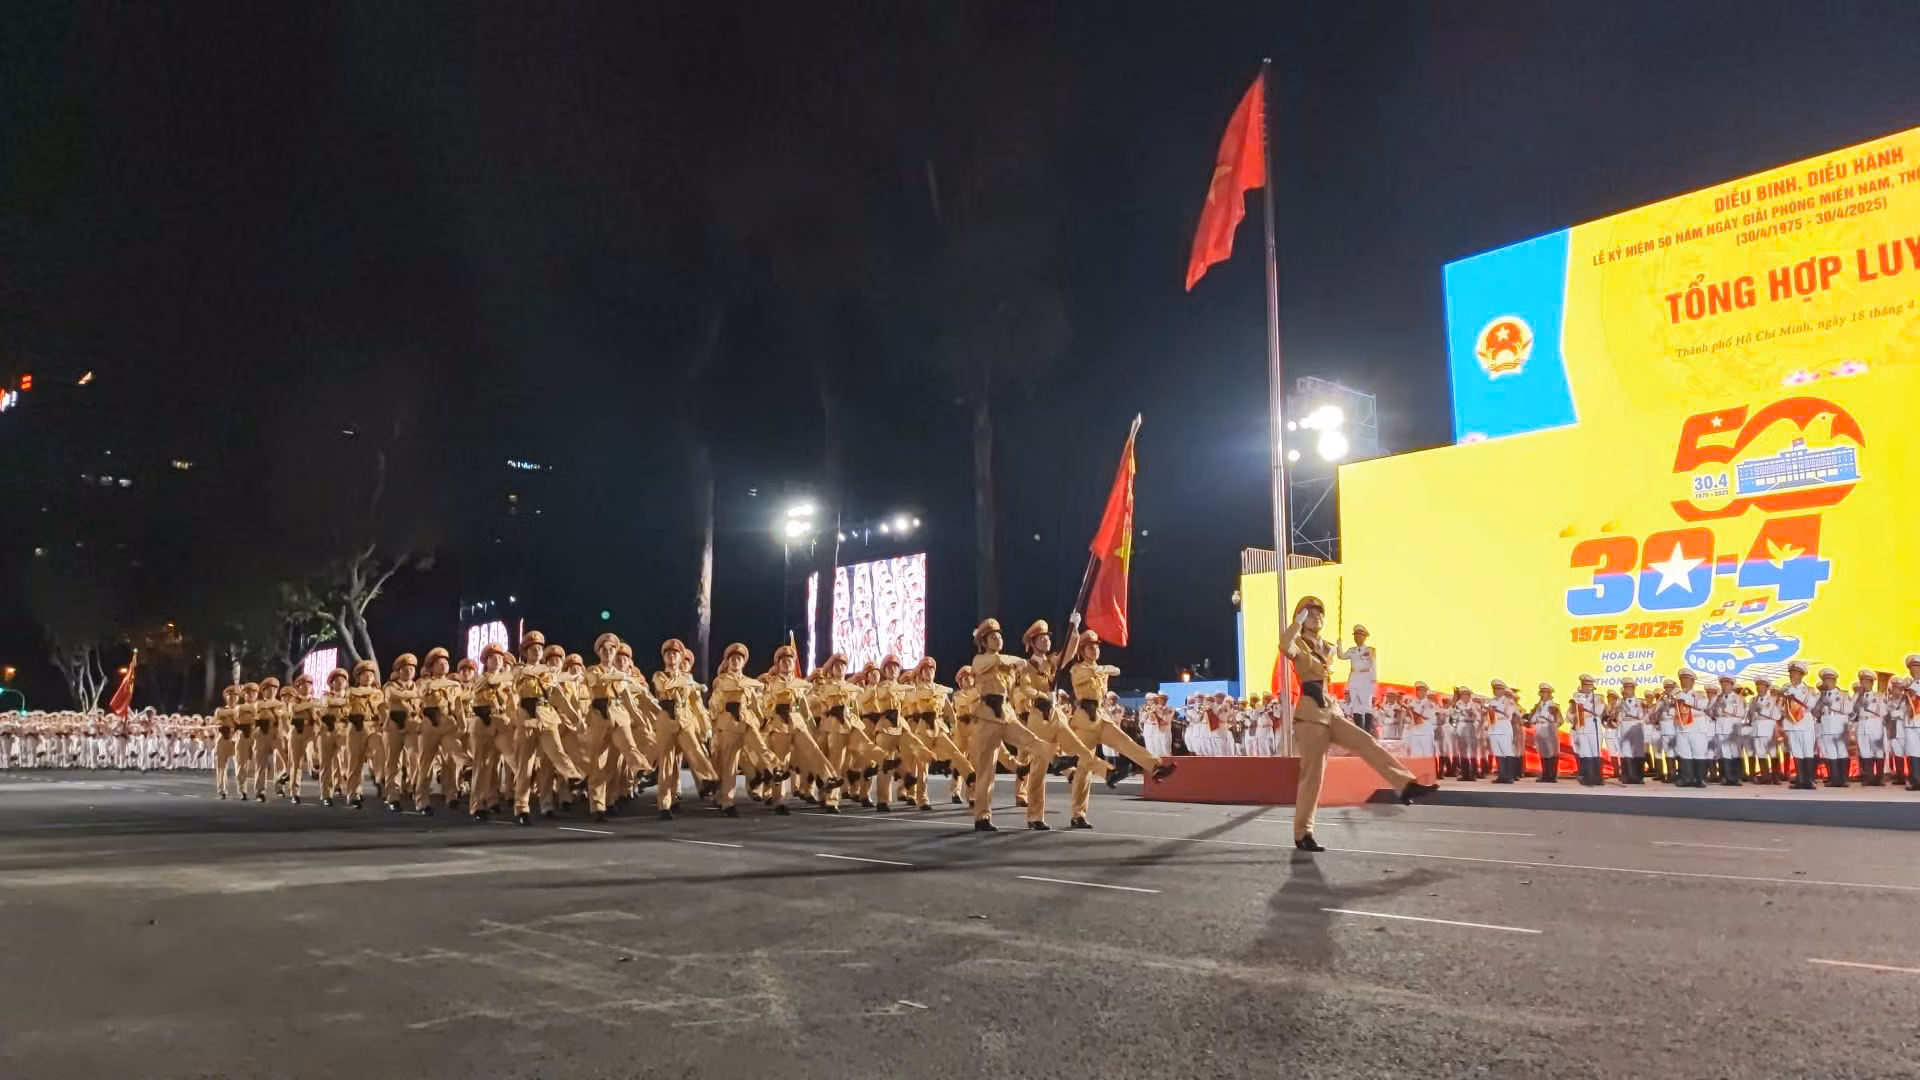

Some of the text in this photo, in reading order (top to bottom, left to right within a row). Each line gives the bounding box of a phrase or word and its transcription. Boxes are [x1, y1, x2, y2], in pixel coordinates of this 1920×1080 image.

[1736, 218, 1803, 246] (30/4/1975
[1816, 196, 1887, 225] 30/4/2025)
[1658, 236, 1672, 249] 50
[1665, 273, 1756, 324] TỔNG
[1768, 256, 1842, 303] HỢP
[1675, 343, 1708, 359] Thành
[1711, 336, 1733, 353] phố
[1735, 332, 1752, 347] Hồ
[1755, 328, 1776, 342] Chí
[1818, 316, 1846, 331] ngày
[1851, 309, 1865, 322] 18
[1869, 303, 1904, 319] tháng
[1694, 473, 1728, 491] 30.4
[1570, 620, 1684, 643] 1975-2025
